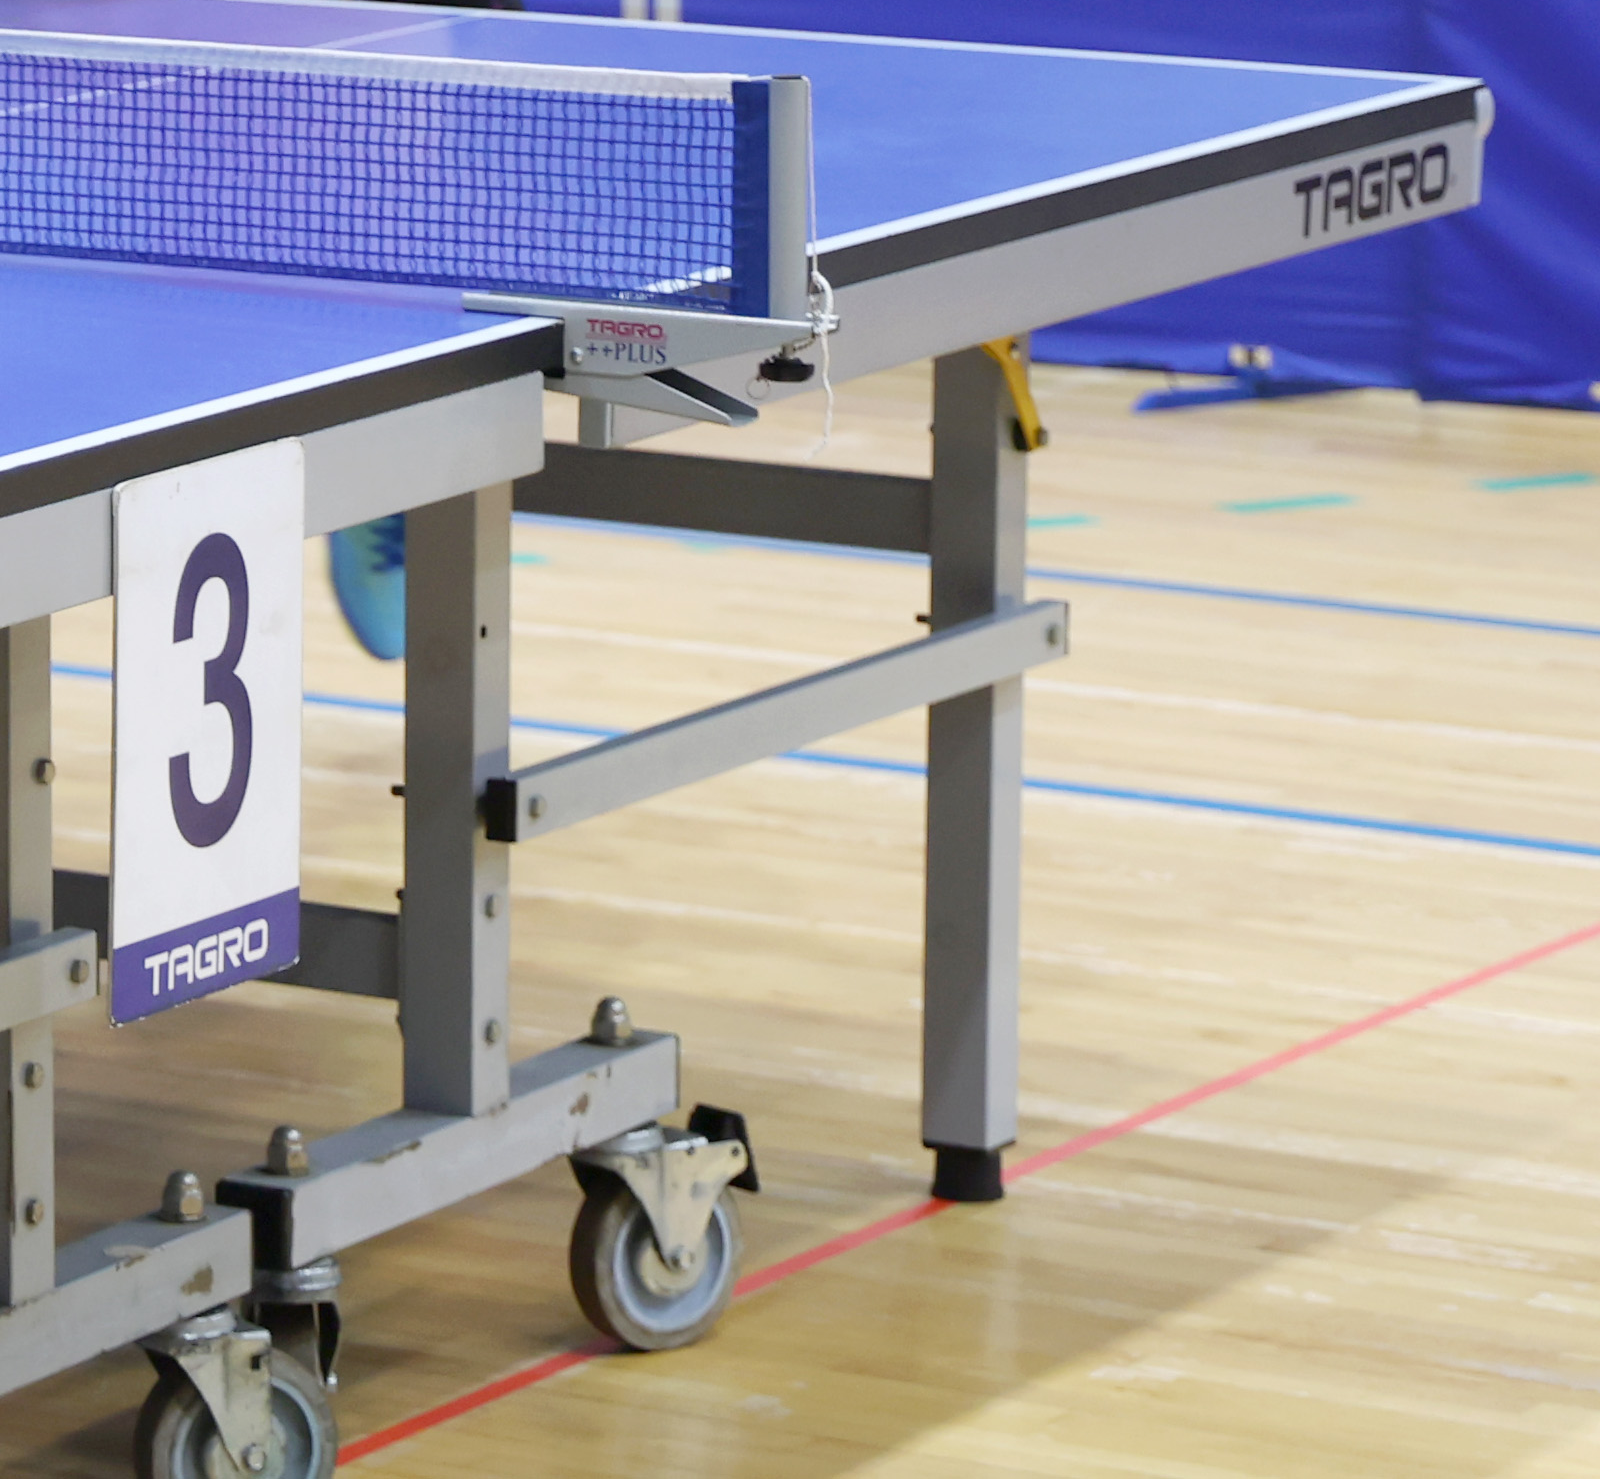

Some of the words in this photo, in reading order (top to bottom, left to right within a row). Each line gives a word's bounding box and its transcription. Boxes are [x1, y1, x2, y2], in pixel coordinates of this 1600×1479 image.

[1294, 143, 1448, 238] TAGRO
[586, 319, 663, 338] TAGRO
[168, 532, 253, 848] 3
[144, 917, 269, 997] TAGRO
